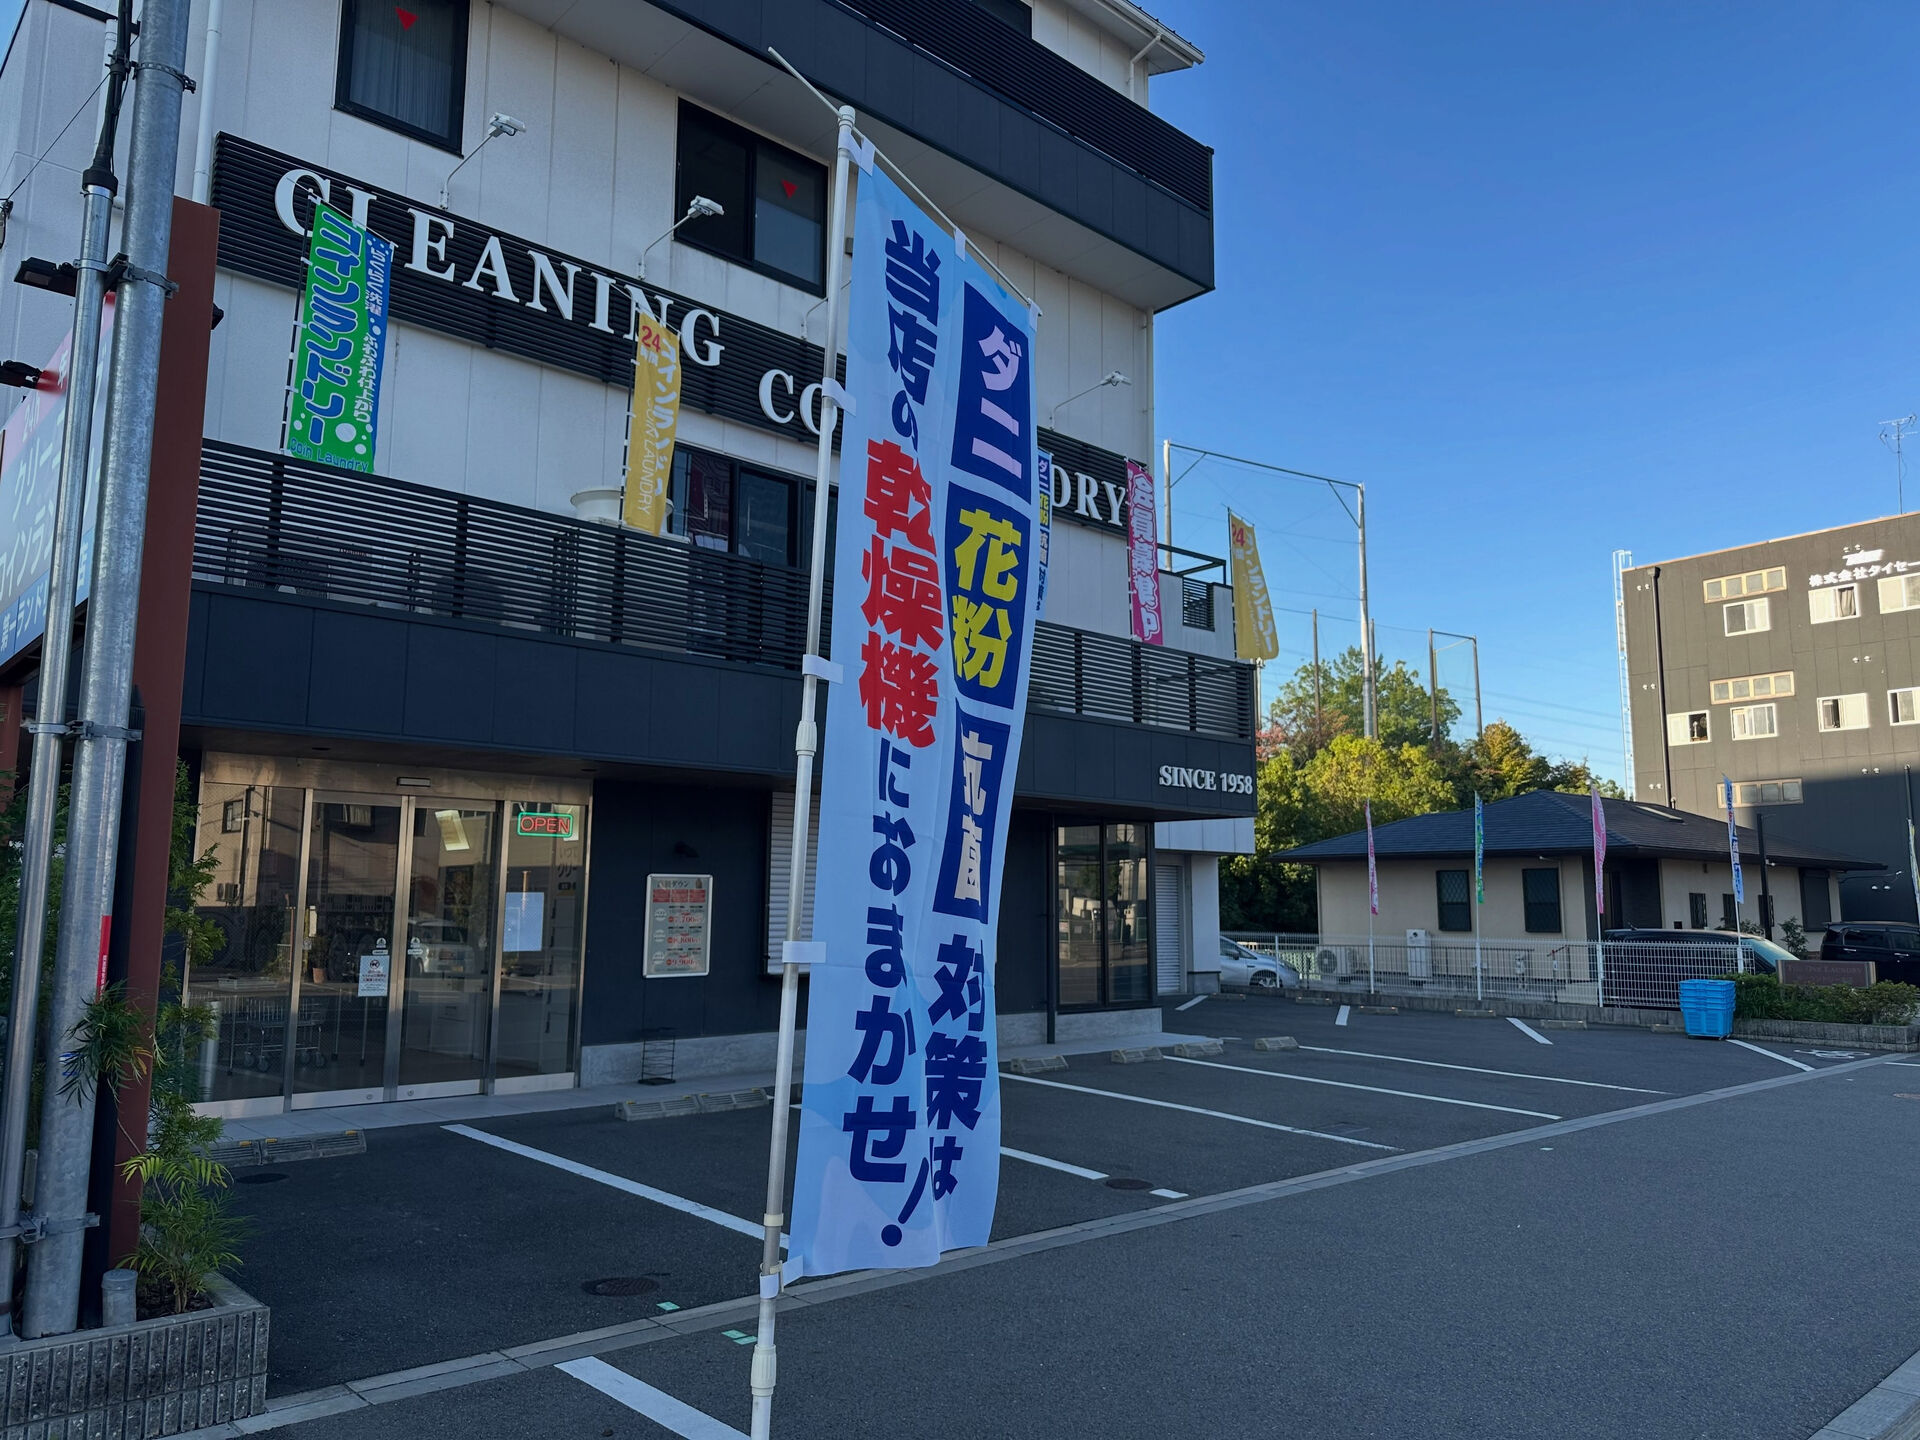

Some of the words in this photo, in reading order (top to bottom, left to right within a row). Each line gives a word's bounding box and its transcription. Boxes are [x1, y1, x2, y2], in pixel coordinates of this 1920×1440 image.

[301, 211, 363, 446] コインランドリー
[641, 325, 661, 353] 24
[971, 325, 1023, 480] ダニ
[289, 438, 313, 460] Coin
[316, 448, 370, 473] Laundry
[953, 507, 1022, 689] 花粉
[520, 816, 571, 833] OPEN
[1159, 765, 1217, 791] SINCE
[1220, 772, 1254, 795] 1958
[925, 933, 988, 1201] 対策は
